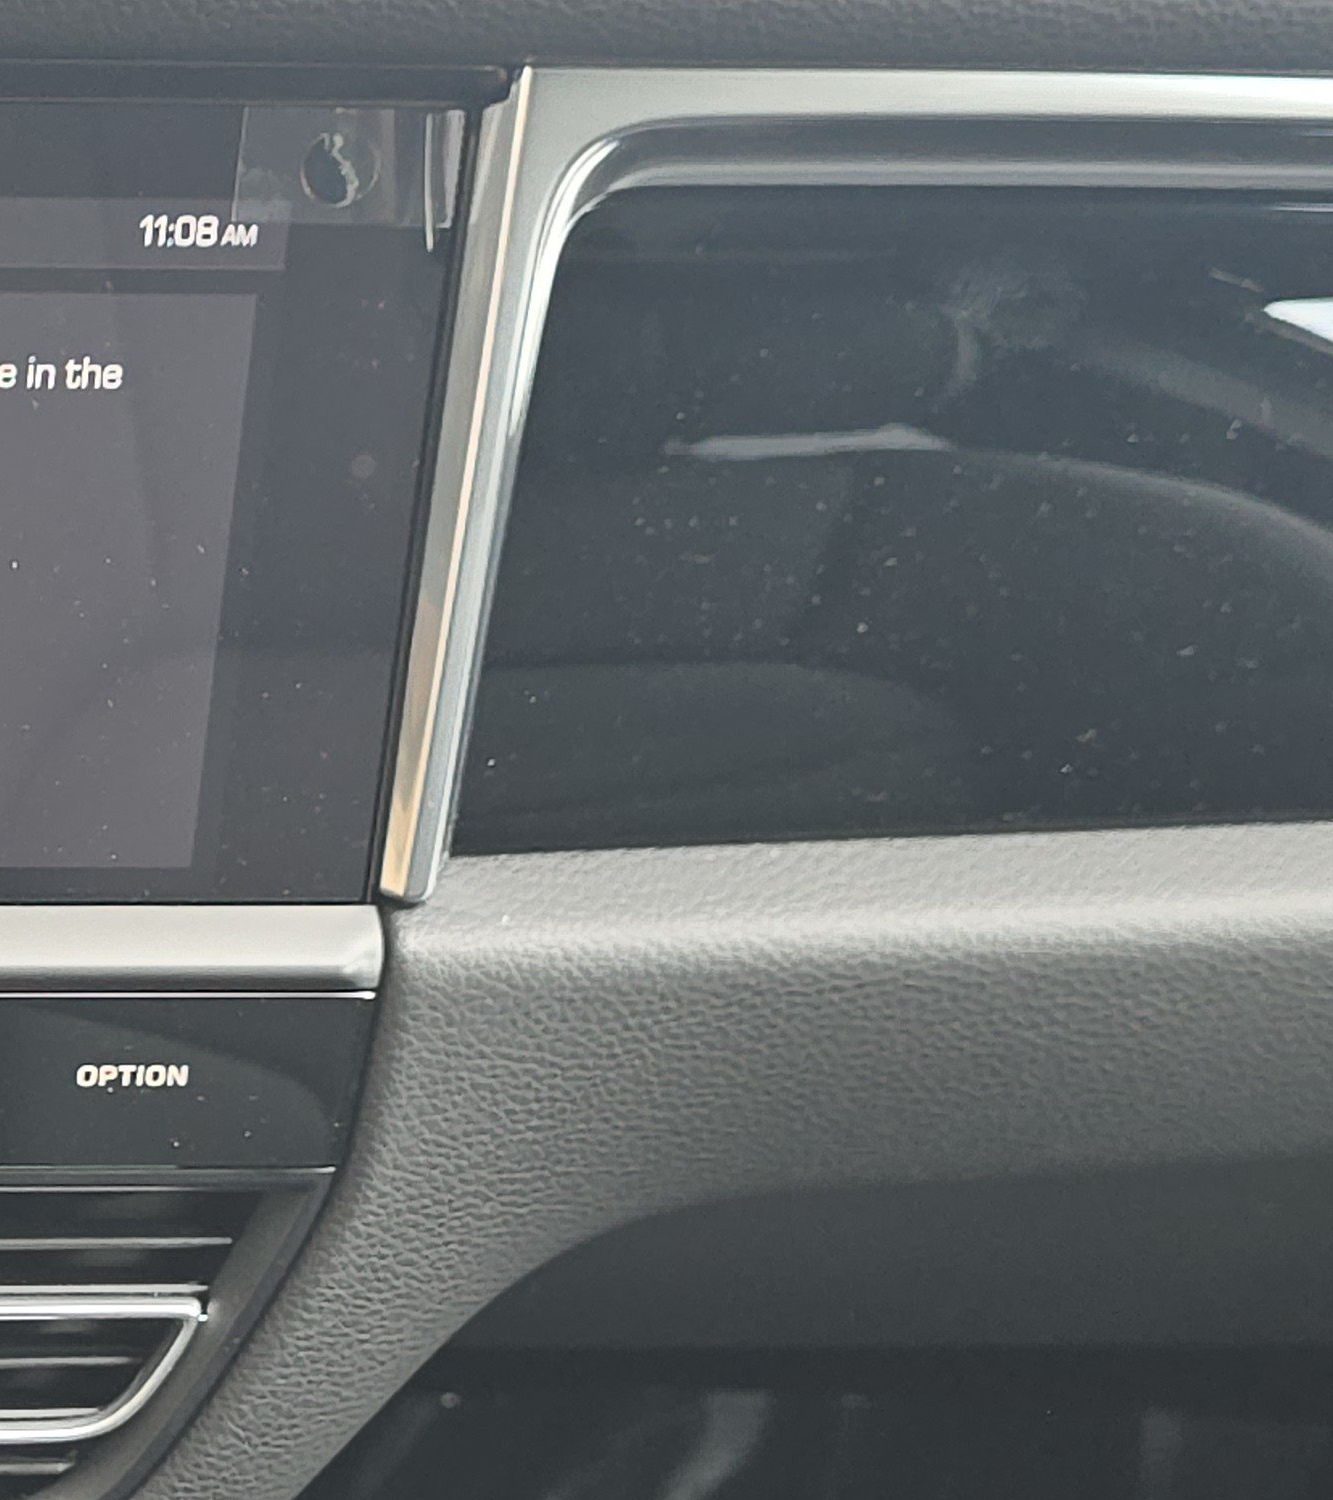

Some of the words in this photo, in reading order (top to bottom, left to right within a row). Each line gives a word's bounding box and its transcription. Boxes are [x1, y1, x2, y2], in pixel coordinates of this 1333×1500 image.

[139, 214, 220, 248] 11:08
[220, 223, 259, 247] AM
[26, 355, 57, 390] in
[64, 356, 123, 390] the
[76, 1064, 189, 1091] OPTION
